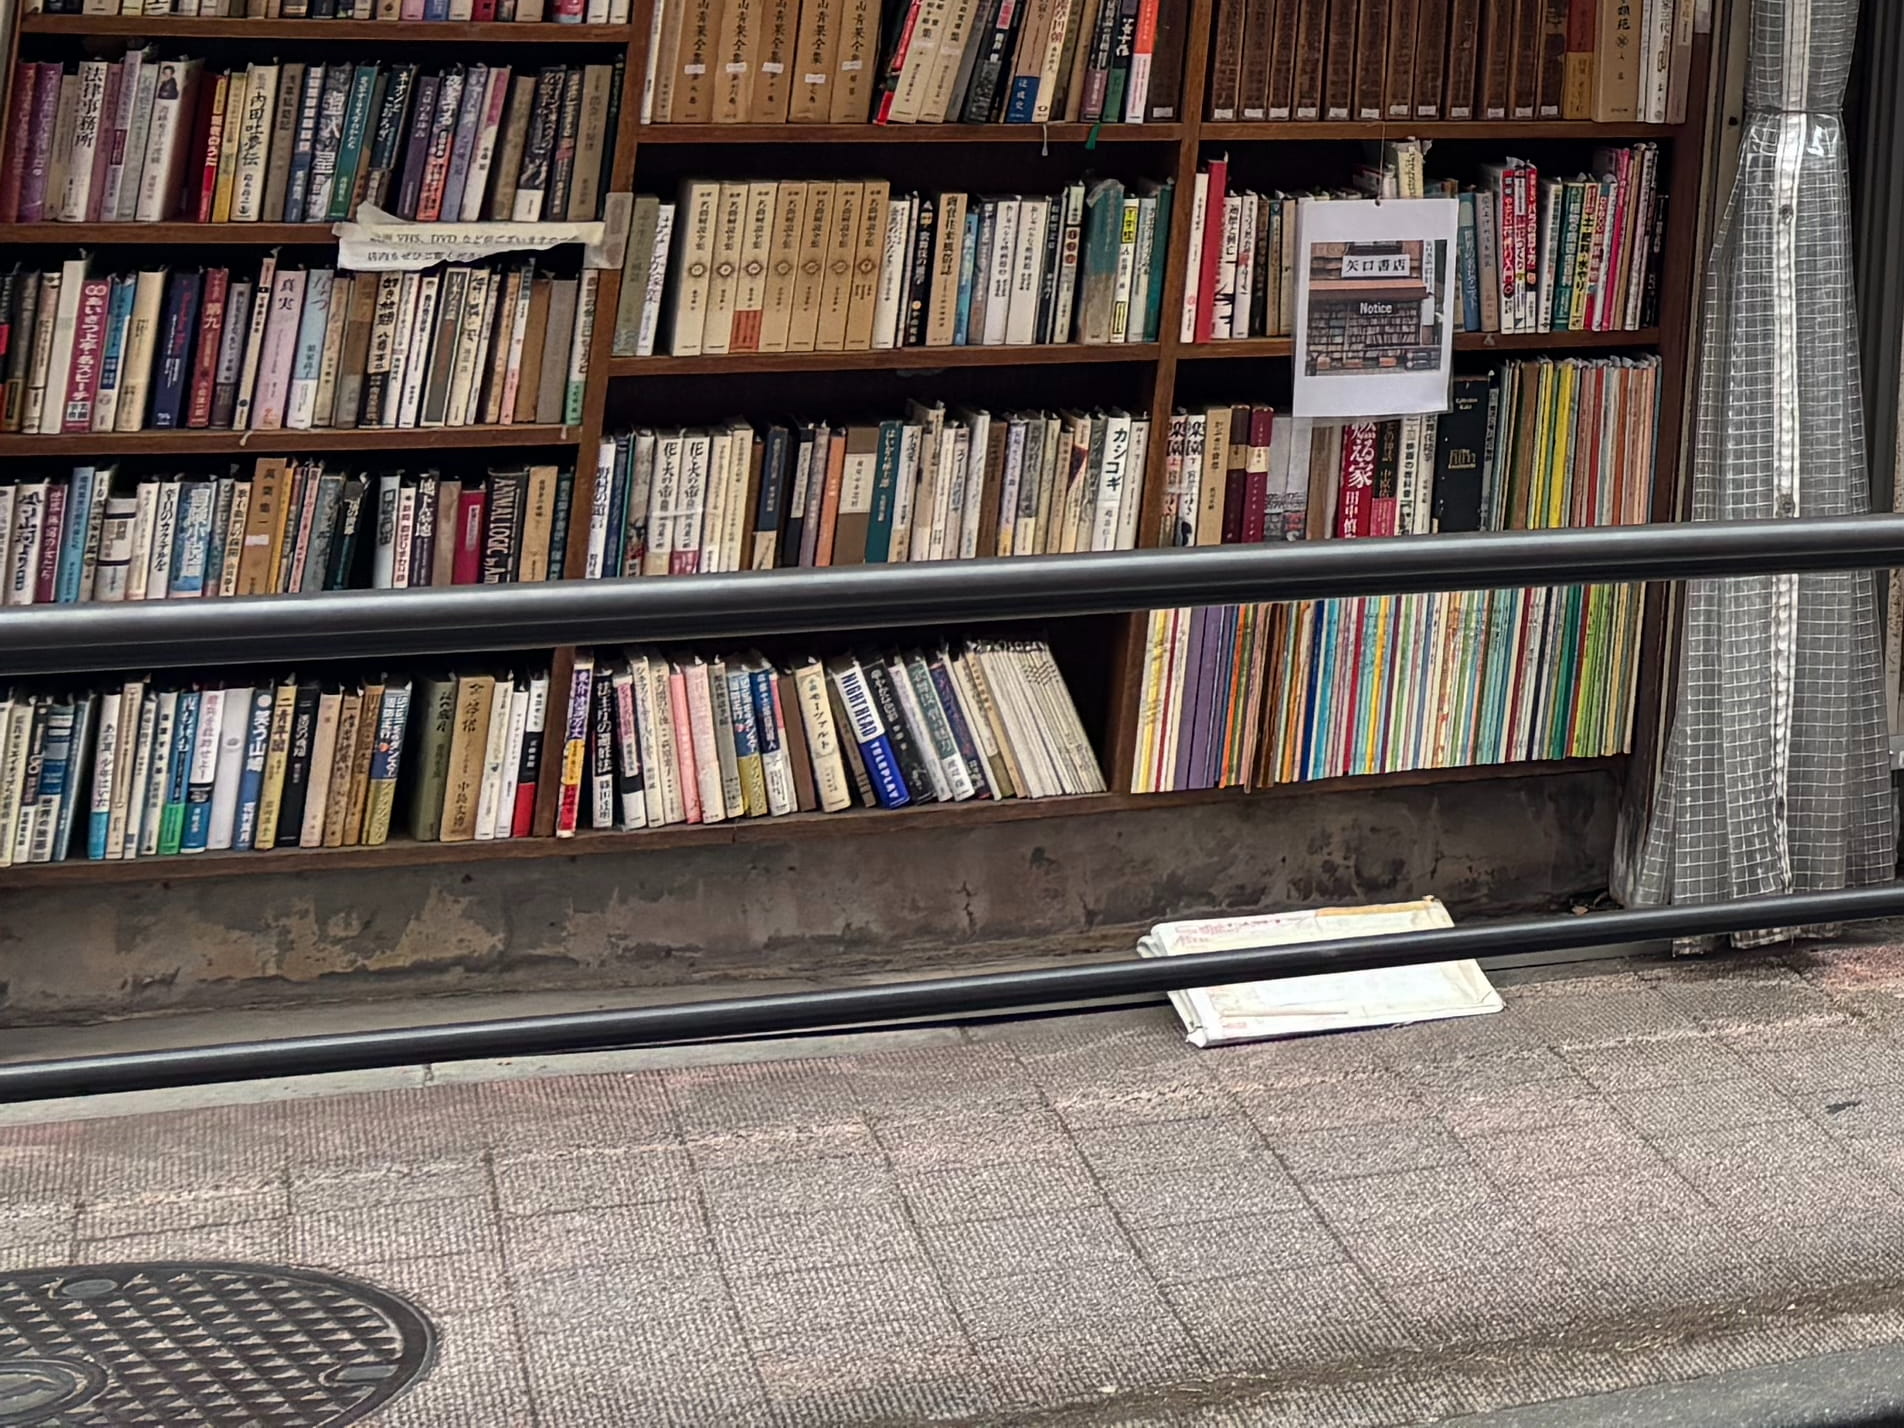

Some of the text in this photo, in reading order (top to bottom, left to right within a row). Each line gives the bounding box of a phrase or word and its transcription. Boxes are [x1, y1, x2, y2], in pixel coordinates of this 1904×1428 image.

[74, 64, 104, 149] 法律事務所
[1344, 257, 1406, 273] 矢口書店
[1359, 302, 1393, 315] Notice
[1348, 422, 1378, 489] 燃える家
[1344, 490, 1360, 539] 田中慎
